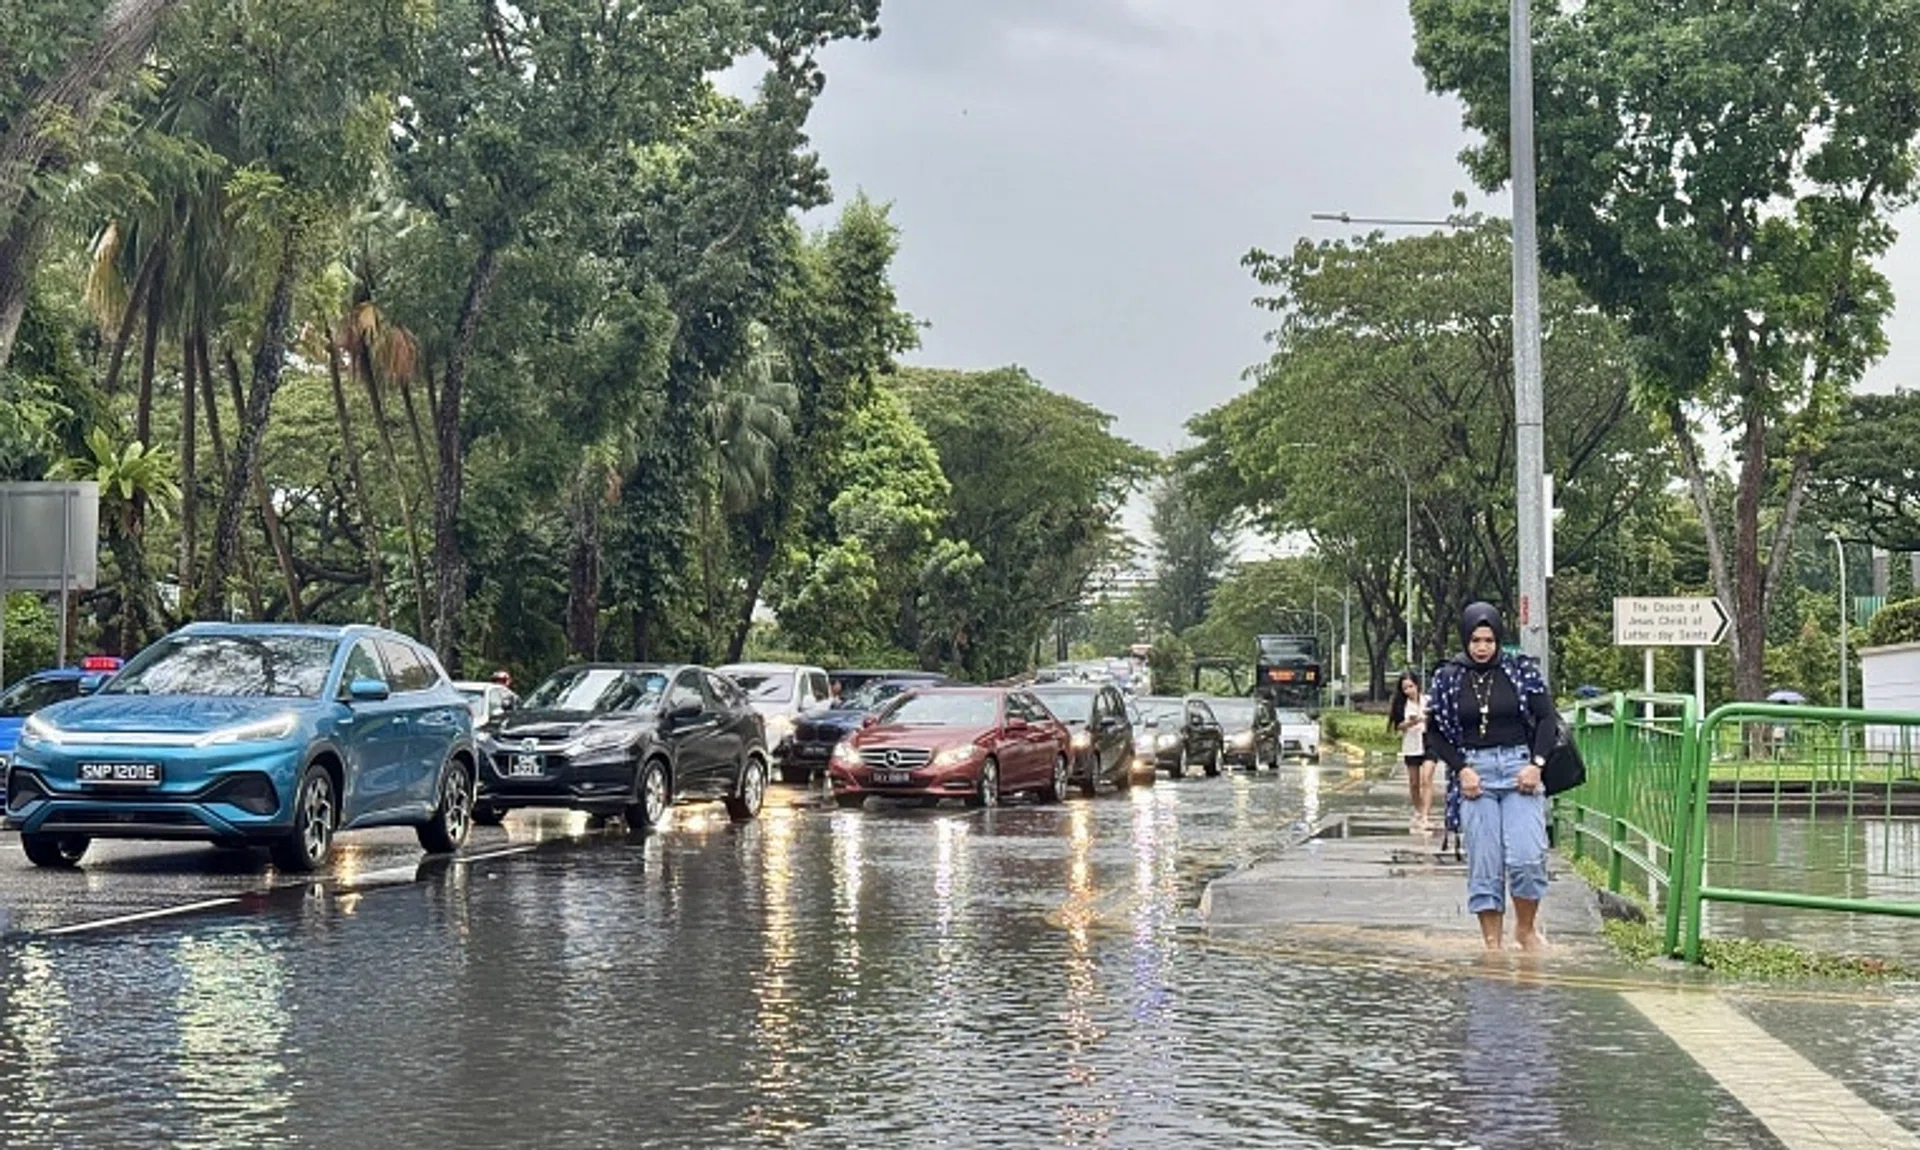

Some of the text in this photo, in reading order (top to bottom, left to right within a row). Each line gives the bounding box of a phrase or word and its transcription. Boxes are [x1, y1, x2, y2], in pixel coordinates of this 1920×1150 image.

[1633, 602, 1700, 612] The Church of
[1628, 616, 1702, 625] Jesus Christ of
[1679, 631, 1708, 640] Saints
